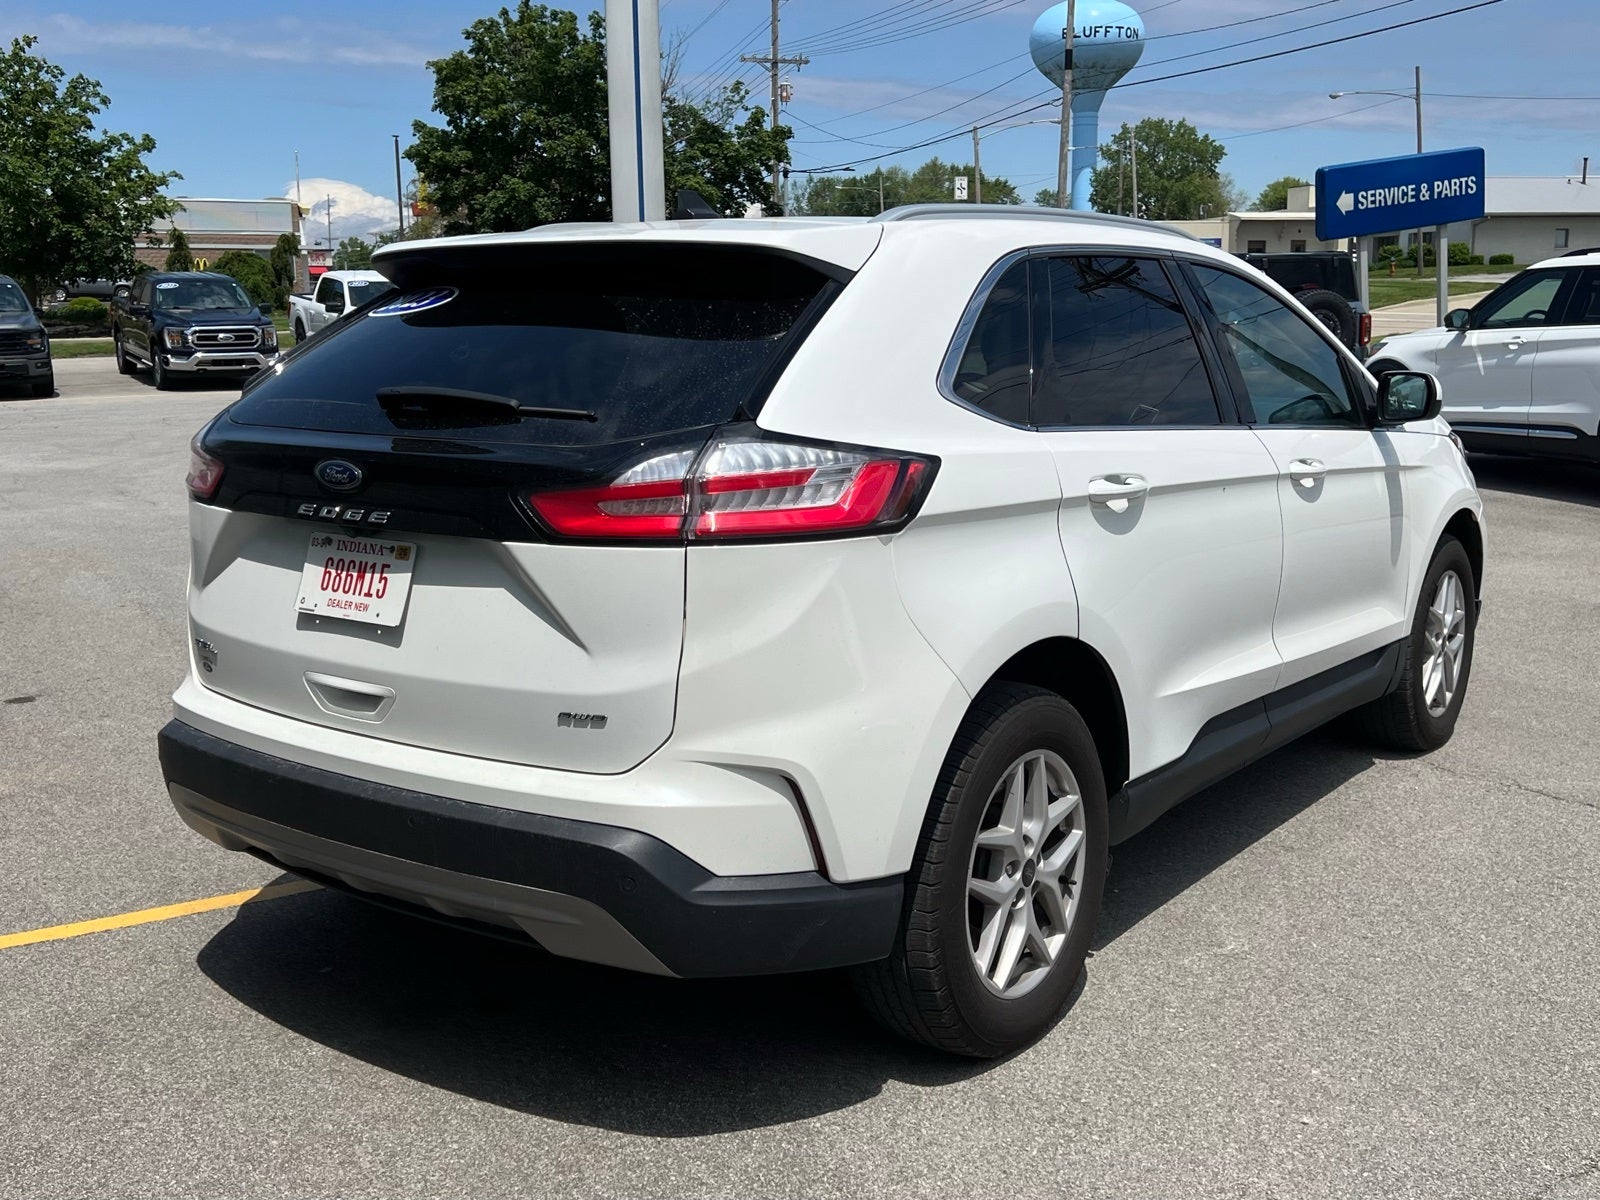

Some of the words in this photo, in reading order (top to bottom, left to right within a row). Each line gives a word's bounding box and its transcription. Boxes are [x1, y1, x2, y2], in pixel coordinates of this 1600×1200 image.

[1357, 184, 1416, 210] SERVICE
[1419, 183, 1430, 201] &
[1433, 175, 1477, 199] PARTS
[324, 465, 350, 483] Ford
[297, 503, 391, 524] EDGE
[336, 539, 384, 556] INDIANA
[320, 556, 391, 599] 686M15
[326, 598, 353, 610] DEALER
[353, 602, 370, 613] NEW
